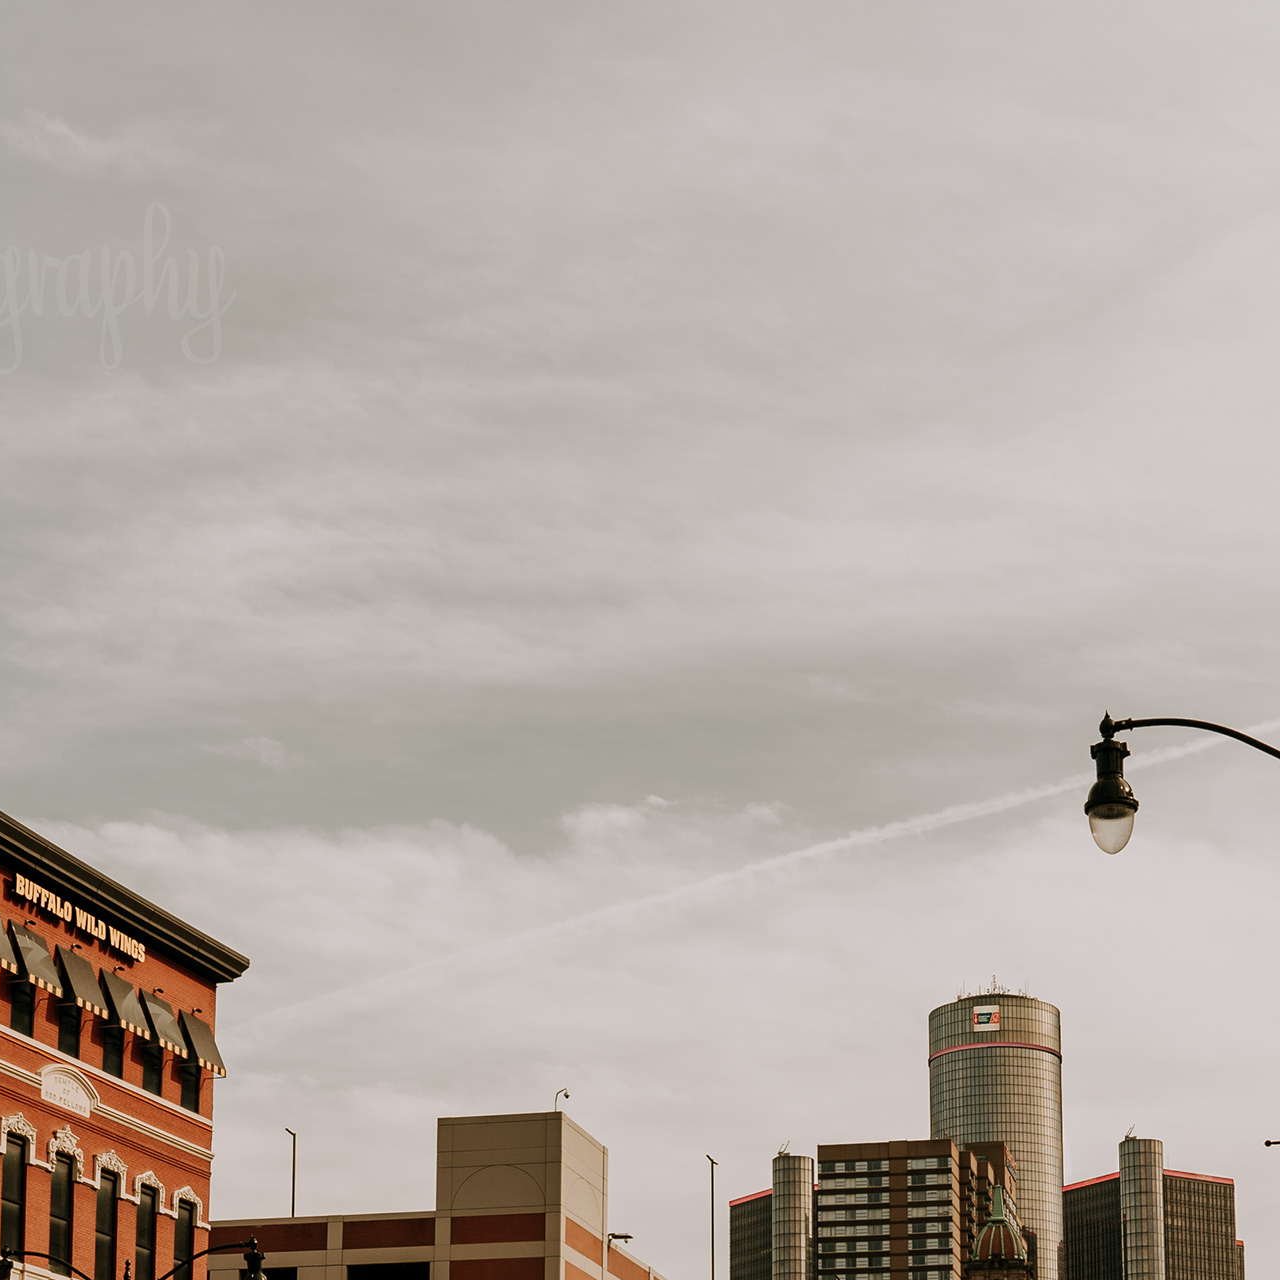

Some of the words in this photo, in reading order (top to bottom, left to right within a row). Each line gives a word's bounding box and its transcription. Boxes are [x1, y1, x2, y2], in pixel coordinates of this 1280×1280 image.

[15, 872, 73, 923] BUFFALO
[74, 905, 107, 941] WILD
[108, 924, 146, 964] WINGS
